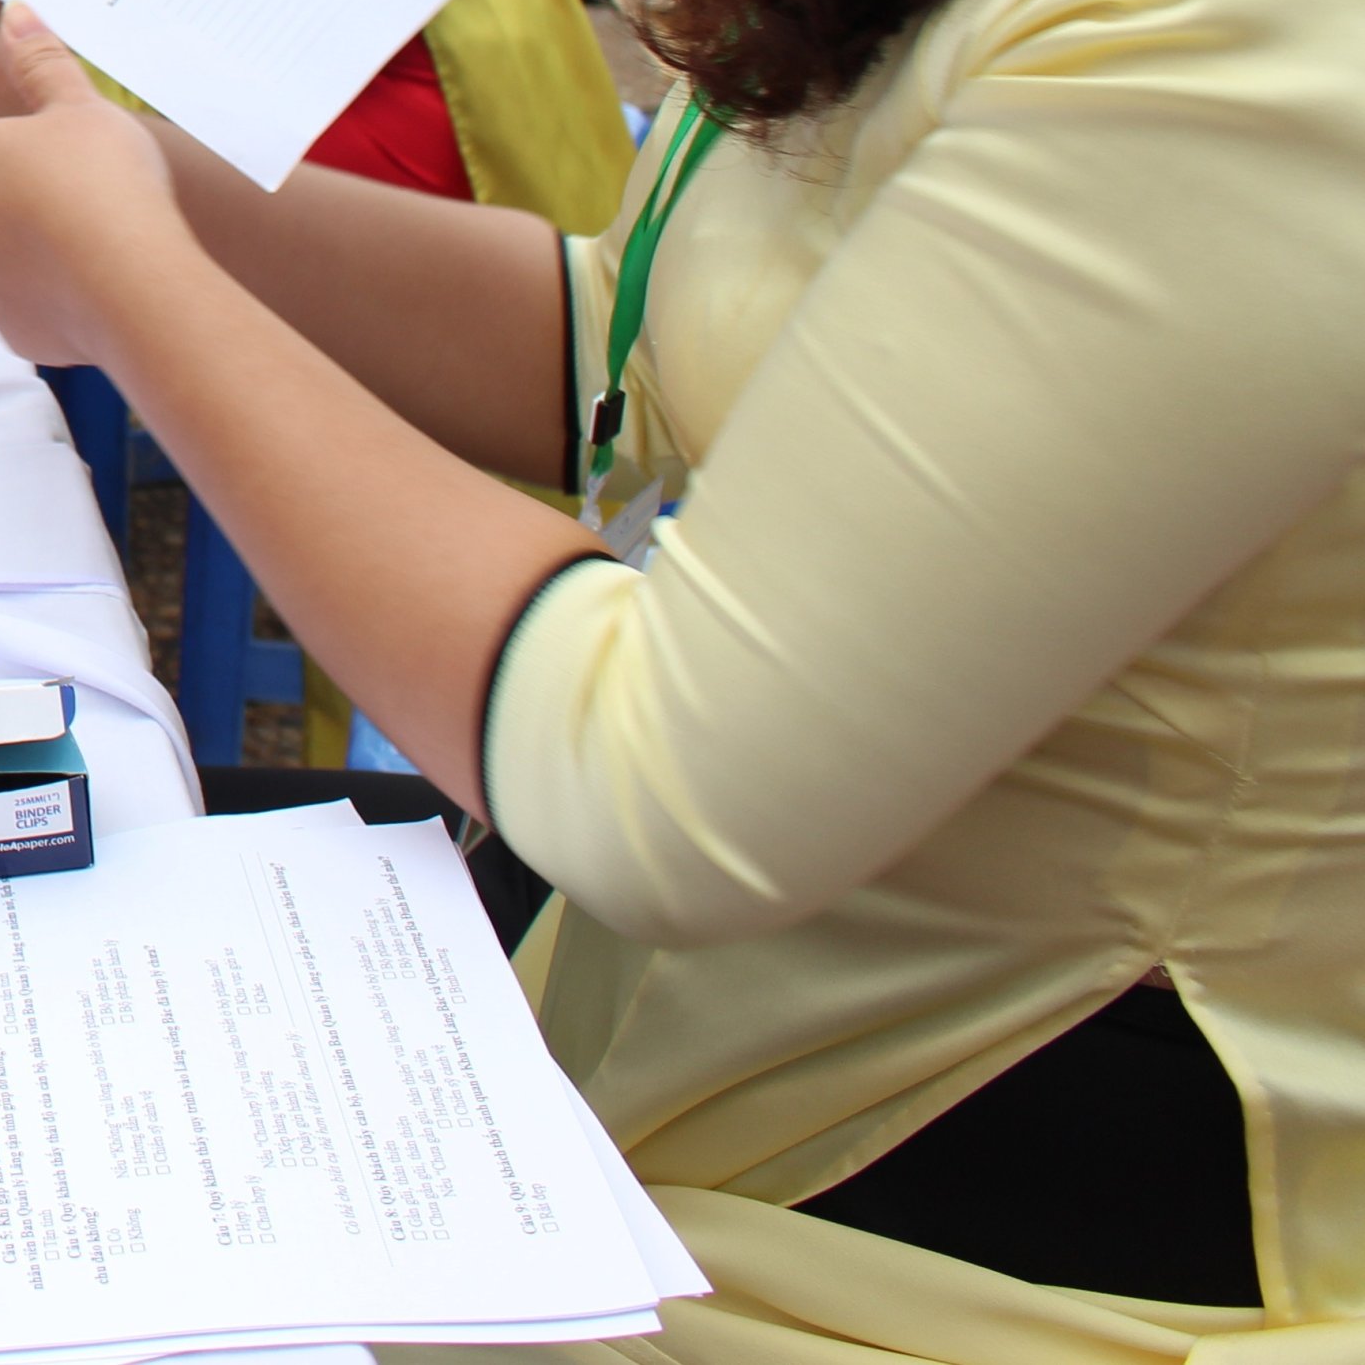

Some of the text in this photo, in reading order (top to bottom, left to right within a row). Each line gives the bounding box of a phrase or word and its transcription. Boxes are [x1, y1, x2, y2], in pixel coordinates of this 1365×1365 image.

[14, 804, 62, 820] BINDER
[16, 816, 49, 829] CLIPS
[181, 1090, 197, 1113] trình
[191, 1116, 206, 1133] quy
[476, 1104, 494, 1126] cảnh
[193, 1136, 209, 1156] thấy
[486, 1128, 503, 1148] thấy
[10, 1151, 23, 1176] Lăng
[199, 1158, 217, 1187] khách
[494, 1149, 515, 1178] khách
[12, 1179, 28, 1188] lý
[509, 1181, 524, 1201] Quý
[15, 1189, 32, 1216] Quản
[208, 1190, 225, 1211] Quý
[514, 1203, 529, 1213] 9:
[20, 1218, 34, 1238] Ban
[212, 1213, 225, 1223] 7:
[520, 1214, 536, 1235] Câu
[81, 1207, 109, 1284] chu đáo không?
[216, 1225, 232, 1246] Câu
[23, 1240, 37, 1261] viên
[28, 1264, 43, 1290] nhân
